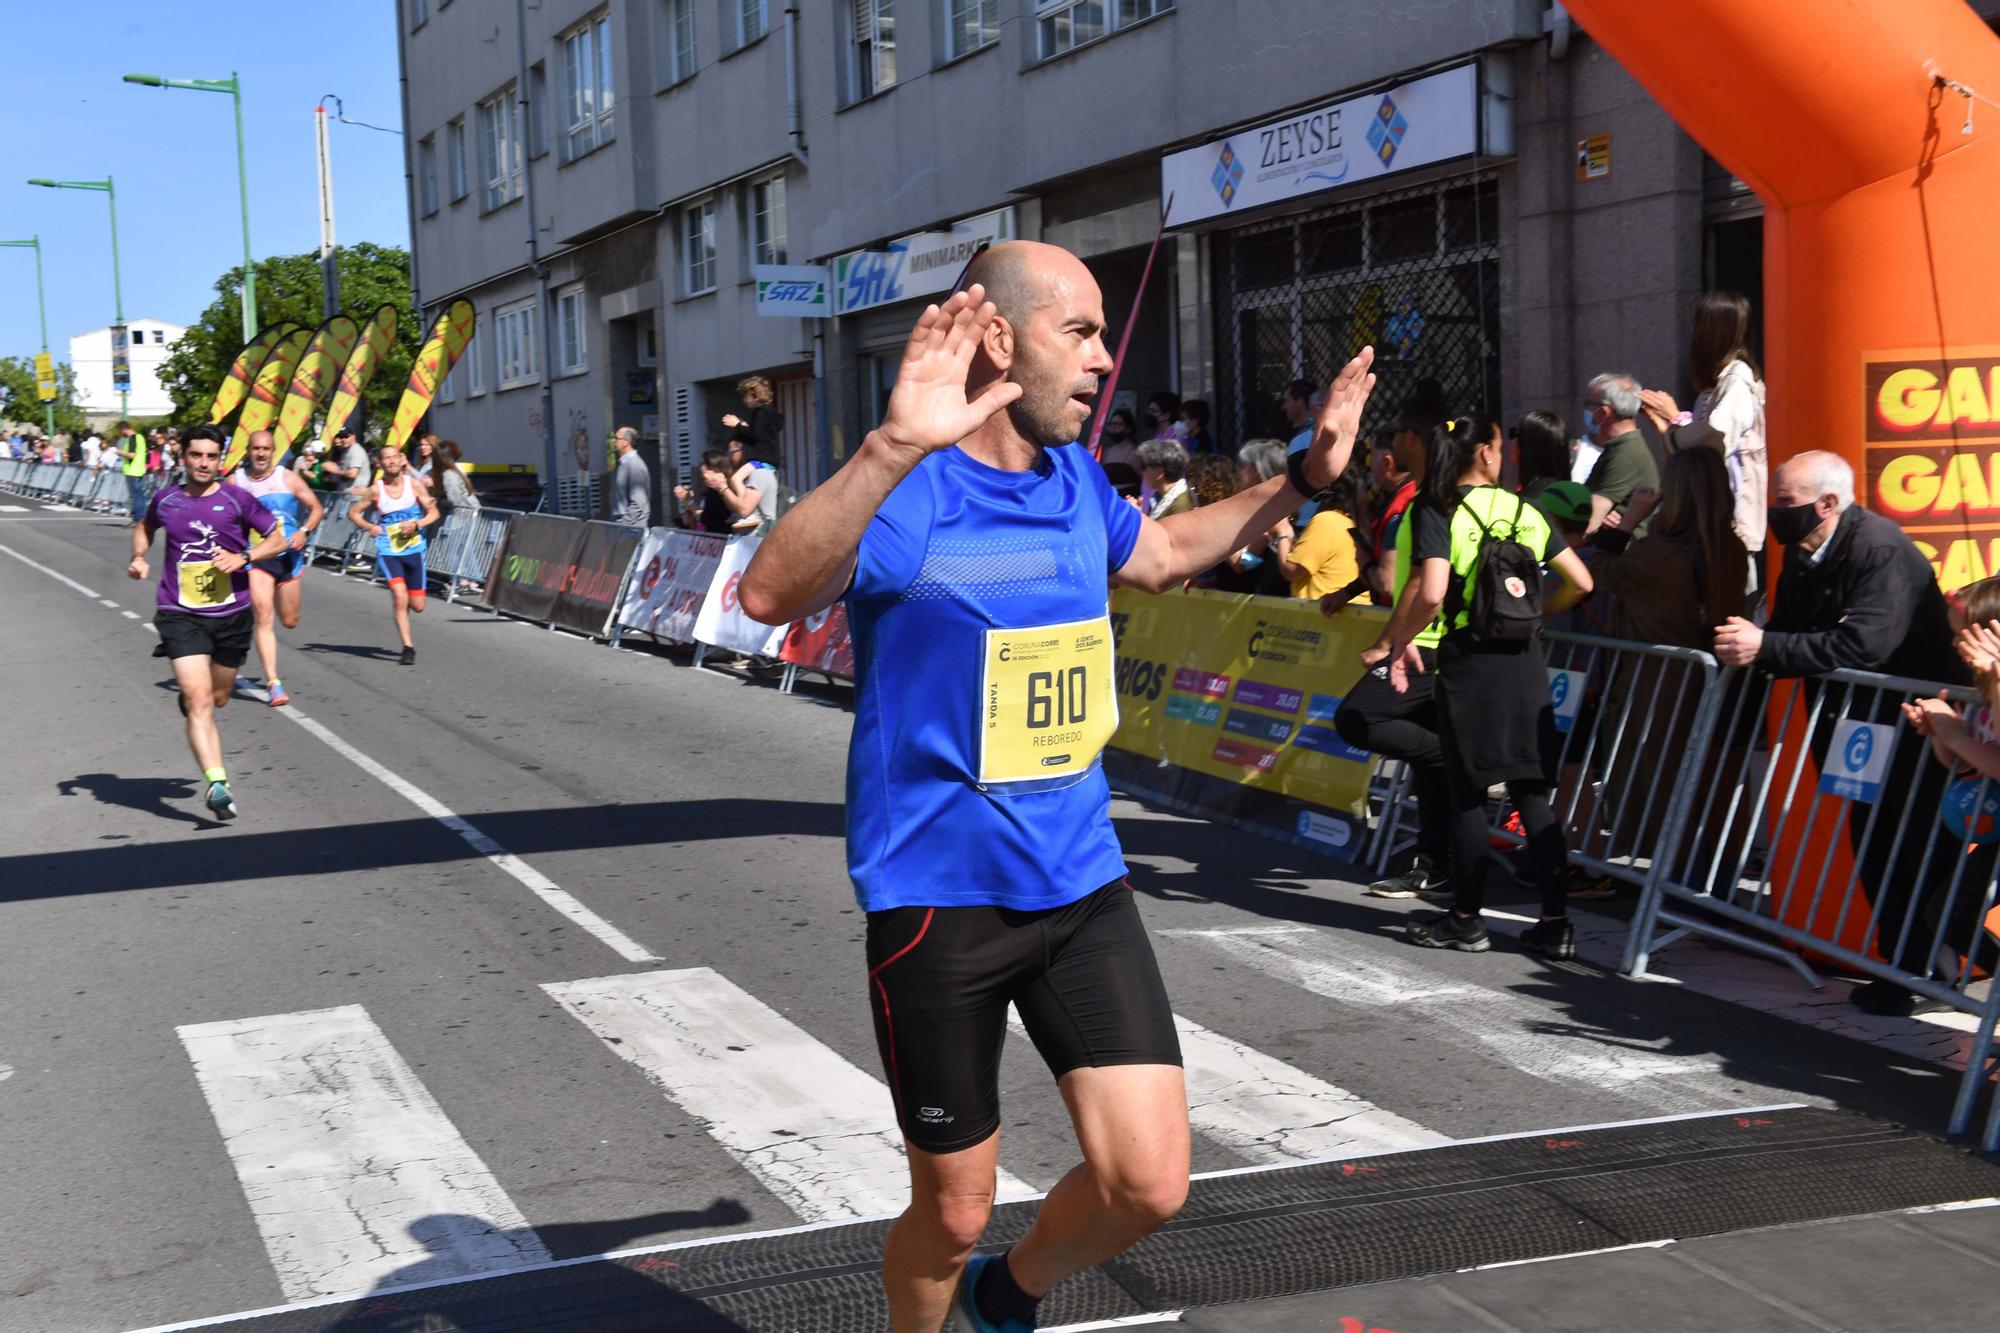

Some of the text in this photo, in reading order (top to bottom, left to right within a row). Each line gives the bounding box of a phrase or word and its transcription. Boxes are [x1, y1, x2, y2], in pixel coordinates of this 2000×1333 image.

[1259, 109, 1343, 168] ZEYSE
[768, 284, 816, 301] SAZ
[847, 240, 912, 309] SAZ
[989, 682, 998, 719] TANDA
[1026, 666, 1086, 729] 610
[1033, 731, 1082, 747] REBOREDO
